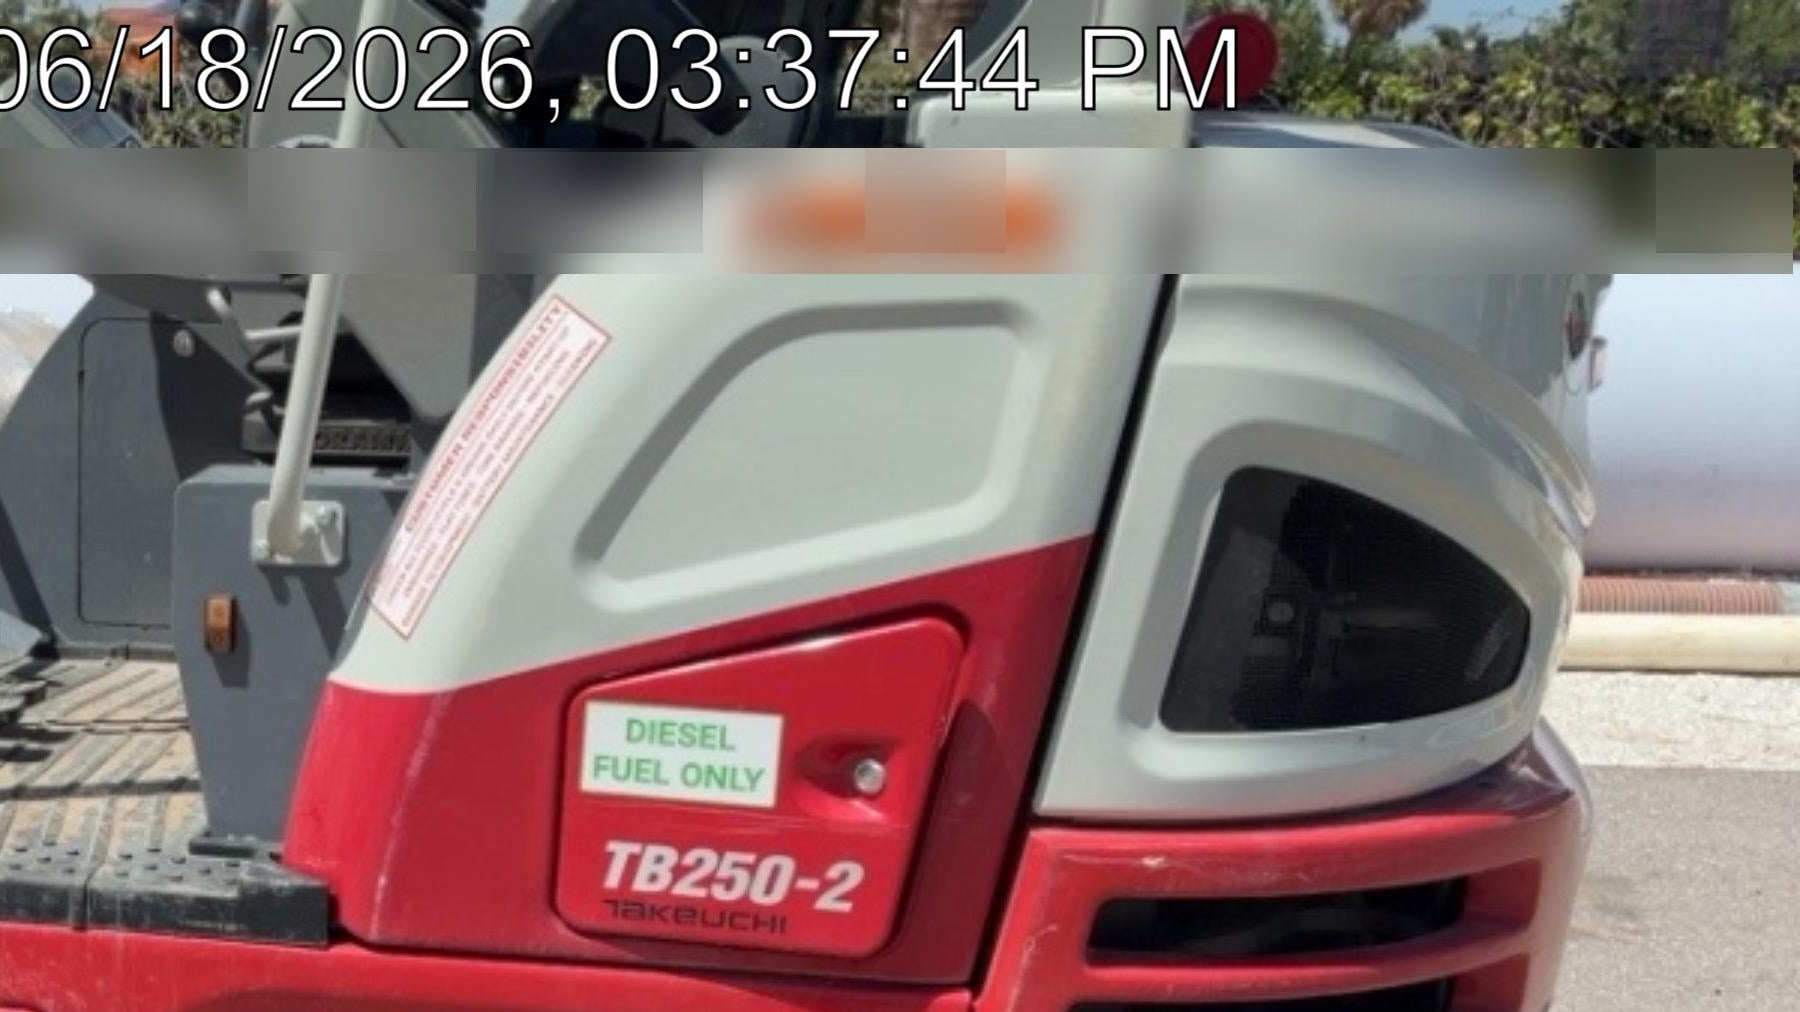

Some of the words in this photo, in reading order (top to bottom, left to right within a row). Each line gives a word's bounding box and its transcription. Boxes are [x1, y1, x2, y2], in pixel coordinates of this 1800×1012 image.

[625, 717, 736, 751] DIESEL
[592, 755, 669, 786] FUEL
[680, 763, 765, 793] ONLY
[603, 840, 865, 913] TB250-2
